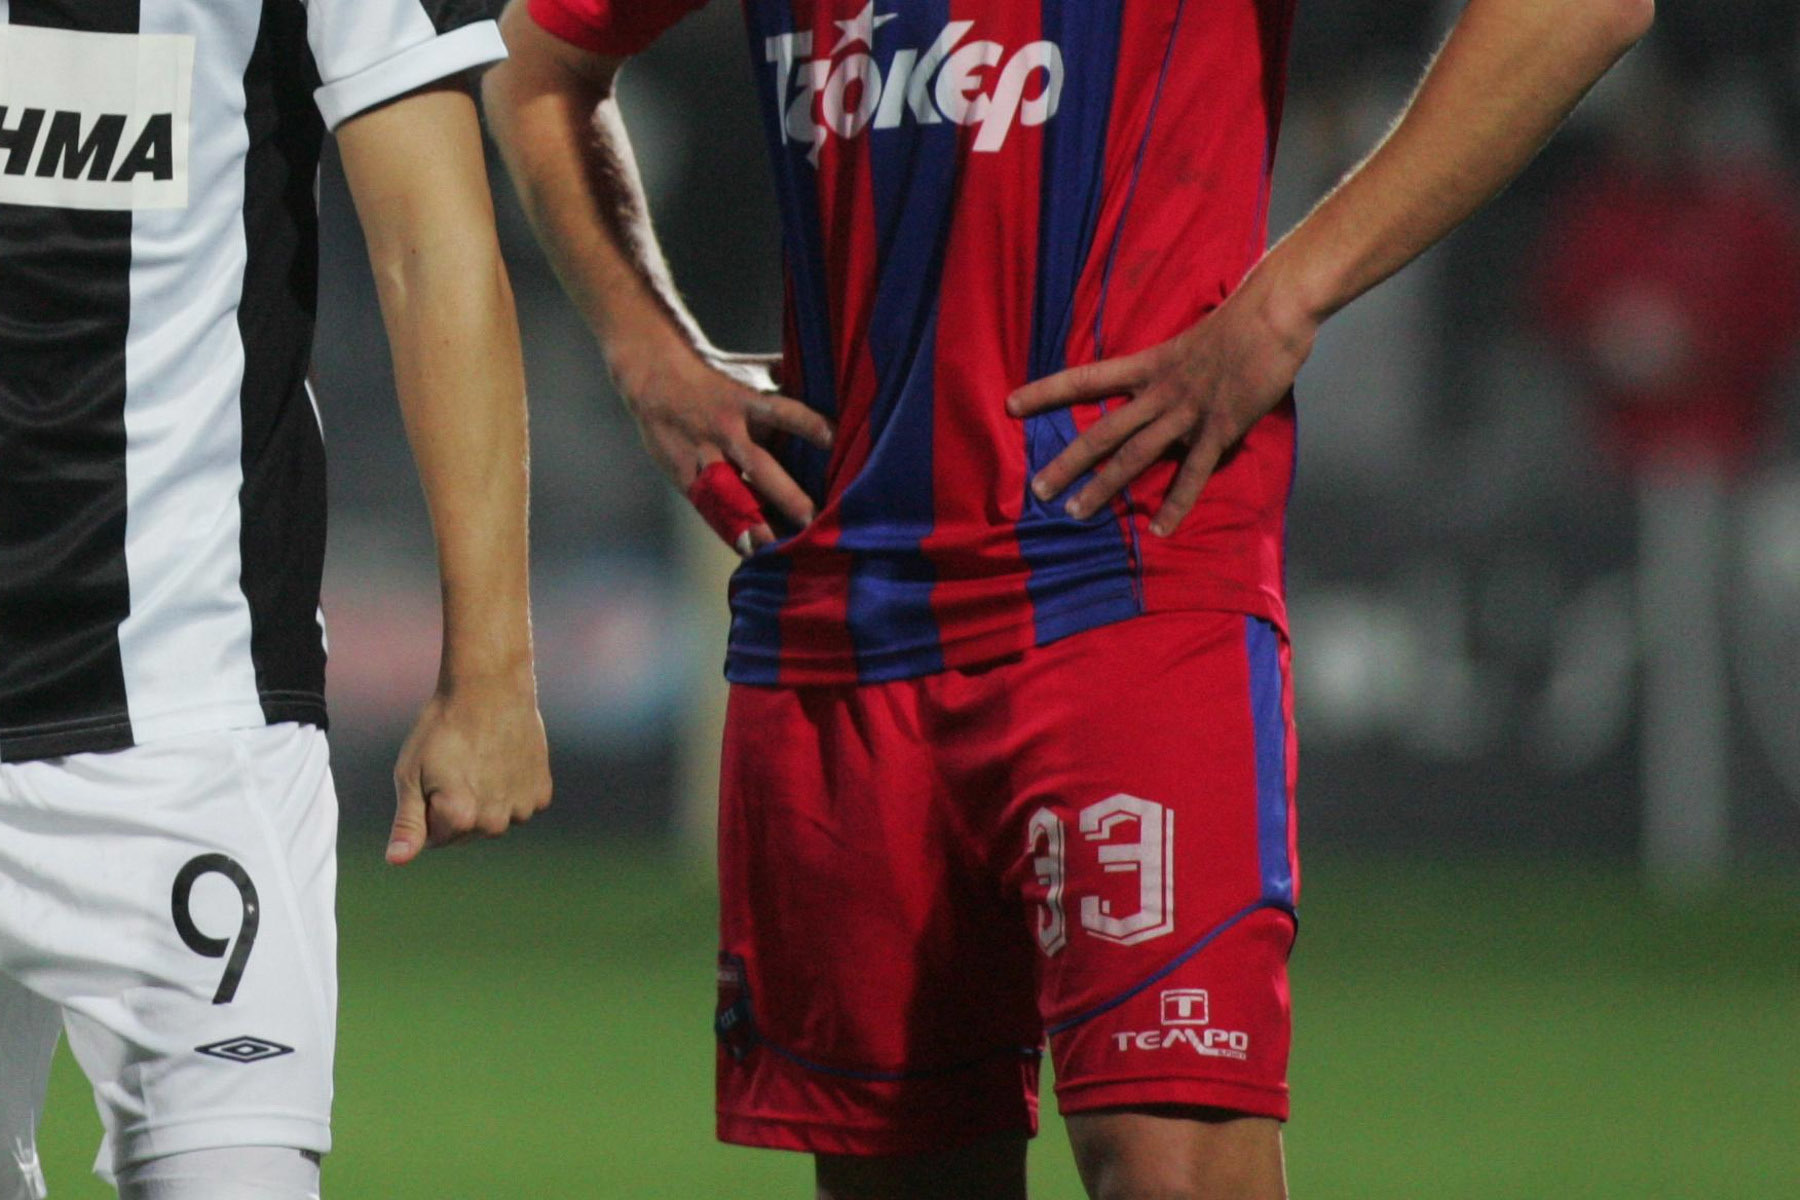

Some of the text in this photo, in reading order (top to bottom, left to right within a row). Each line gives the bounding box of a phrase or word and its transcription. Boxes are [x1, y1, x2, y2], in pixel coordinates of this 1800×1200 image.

[171, 852, 260, 1005] 9
[1027, 793, 1175, 957] 33
[1112, 1028, 1248, 1056] TEMPO
